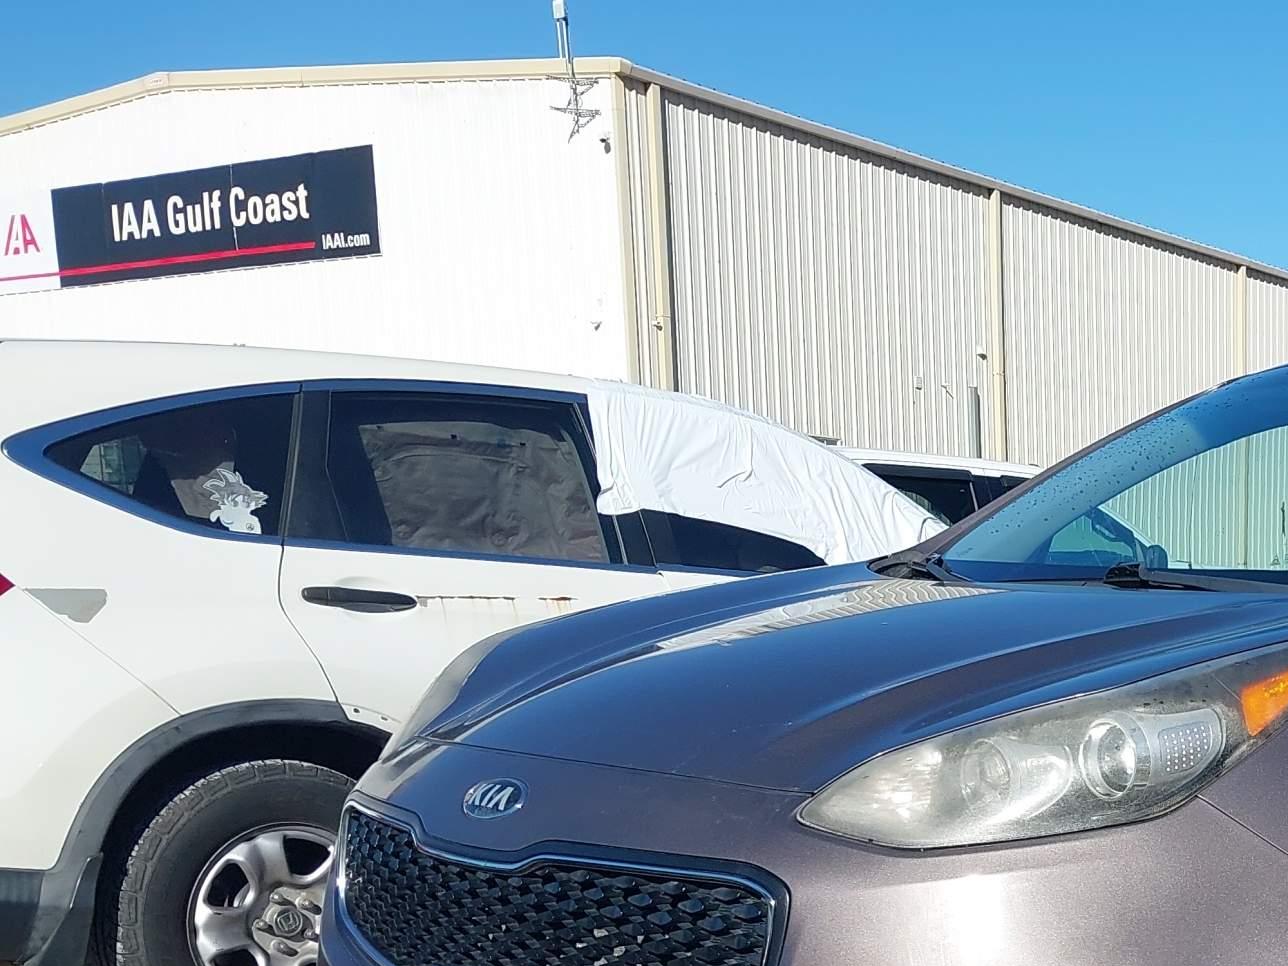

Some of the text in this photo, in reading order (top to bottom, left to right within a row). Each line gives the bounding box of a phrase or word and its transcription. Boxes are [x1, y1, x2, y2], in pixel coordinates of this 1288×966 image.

[111, 183, 310, 242] IAA Gulf Coast
[468, 783, 514, 811] KIA
